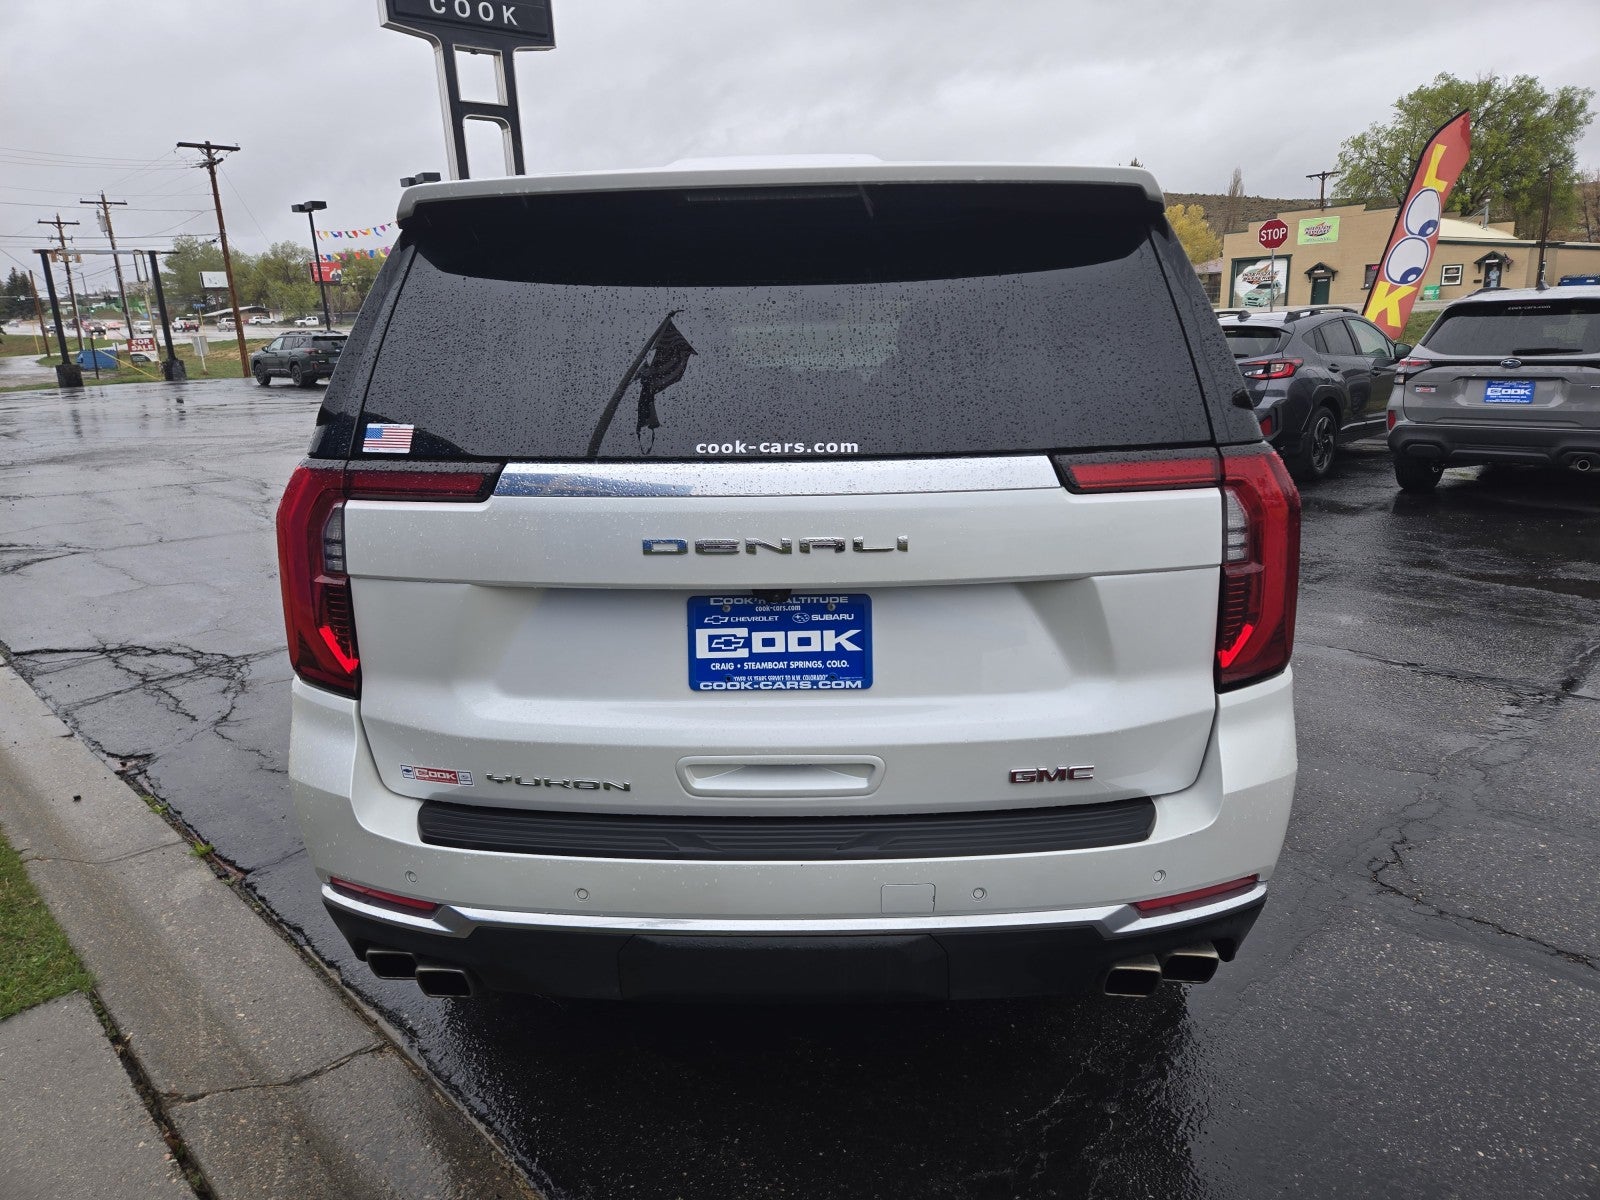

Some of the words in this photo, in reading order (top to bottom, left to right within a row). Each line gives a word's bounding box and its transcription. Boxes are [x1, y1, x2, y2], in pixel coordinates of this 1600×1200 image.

[429, 0, 518, 26] COOK
[1260, 227, 1287, 242] STOP
[1486, 387, 1532, 396] COOK
[696, 440, 860, 454] cook-cars.com
[641, 534, 909, 555] DENALI
[730, 615, 779, 623] CHEVROLET
[811, 613, 854, 621] SUBARU
[695, 627, 863, 659] COOK
[710, 662, 735, 670] CRAIG
[743, 661, 788, 670] STEAMBOAT
[789, 660, 825, 669] SPRINGS,
[826, 659, 850, 668] COLO.
[699, 681, 862, 690] COOK-CARS.COM
[415, 768, 457, 780] COOK
[1009, 764, 1095, 783] GMC
[485, 772, 632, 792] YUKON
